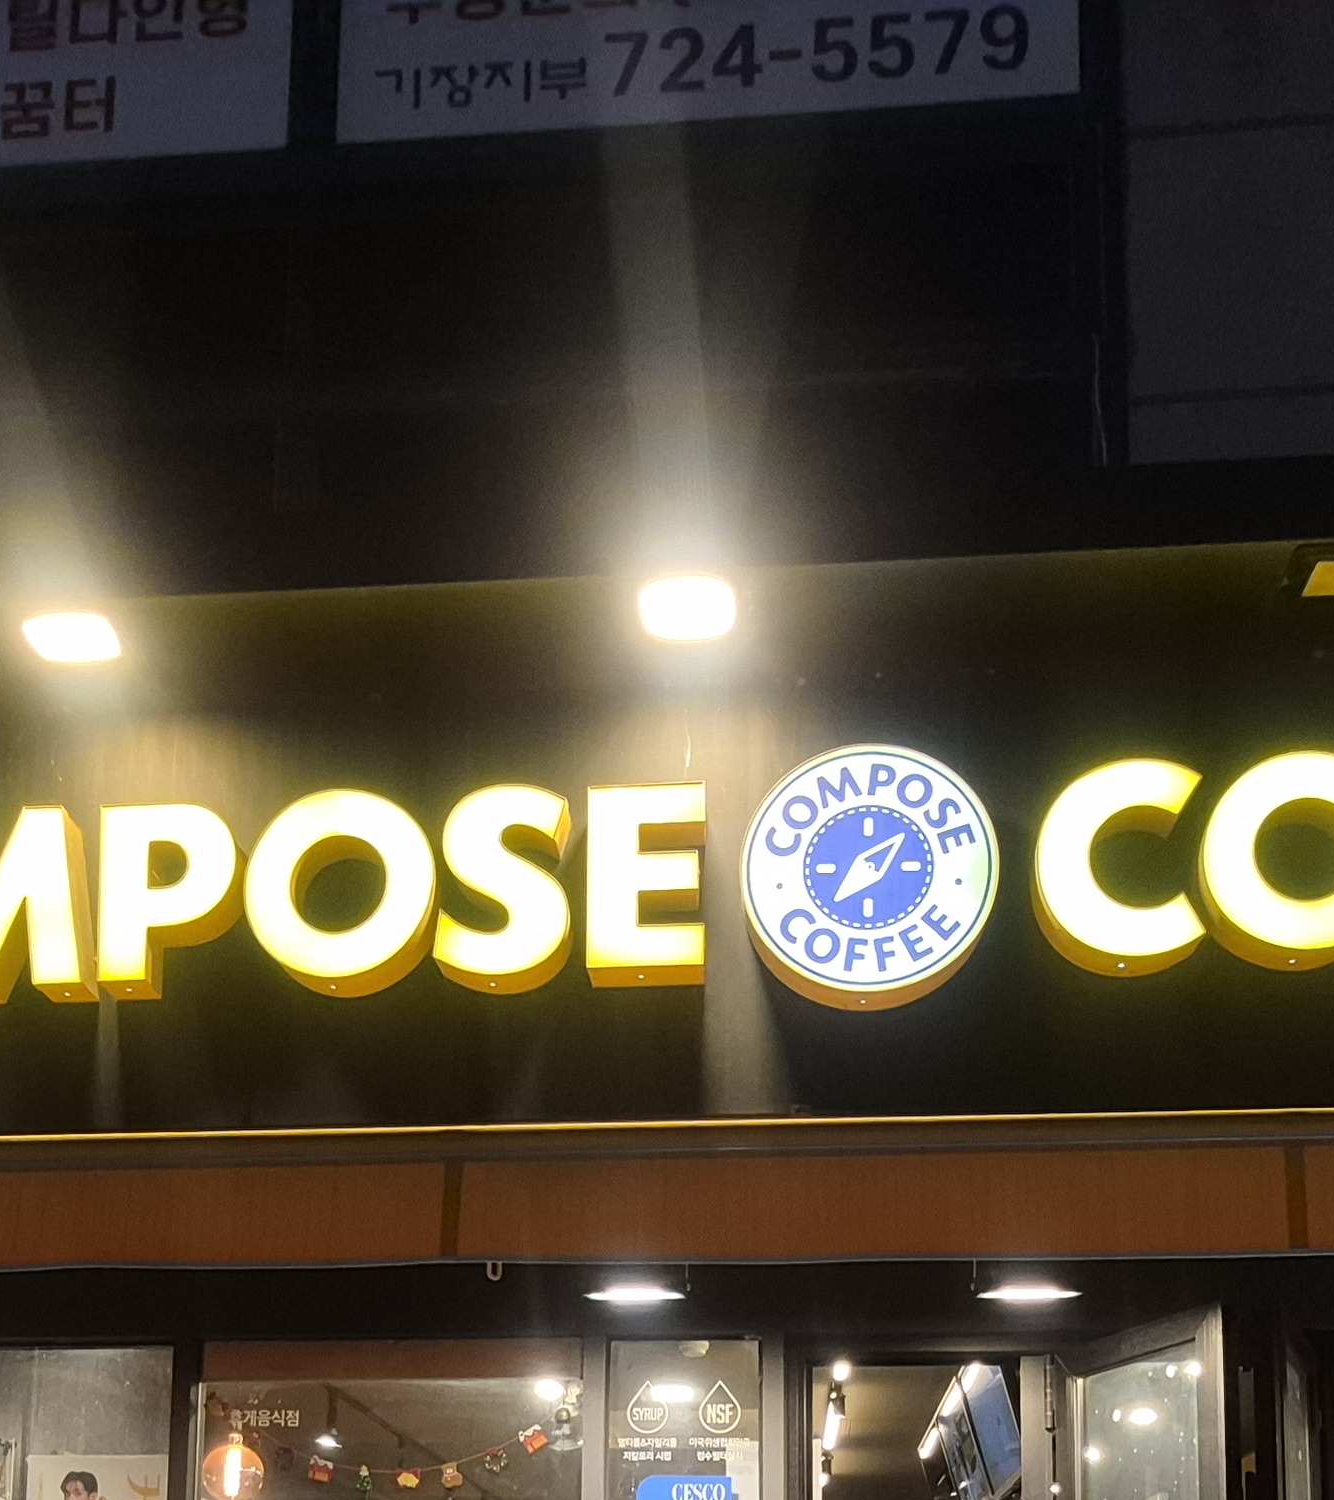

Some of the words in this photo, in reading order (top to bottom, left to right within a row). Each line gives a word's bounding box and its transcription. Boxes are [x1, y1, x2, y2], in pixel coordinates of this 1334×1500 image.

[375, 58, 588, 109] 기장지부
[603, 3, 1031, 97] 724-5579
[0, 76, 117, 140] 꿈터
[765, 763, 976, 857] COMPOSE
[779, 903, 962, 972] COFFEE
[632, 1407, 664, 1421] SYRUP
[706, 1403, 734, 1424] NSF
